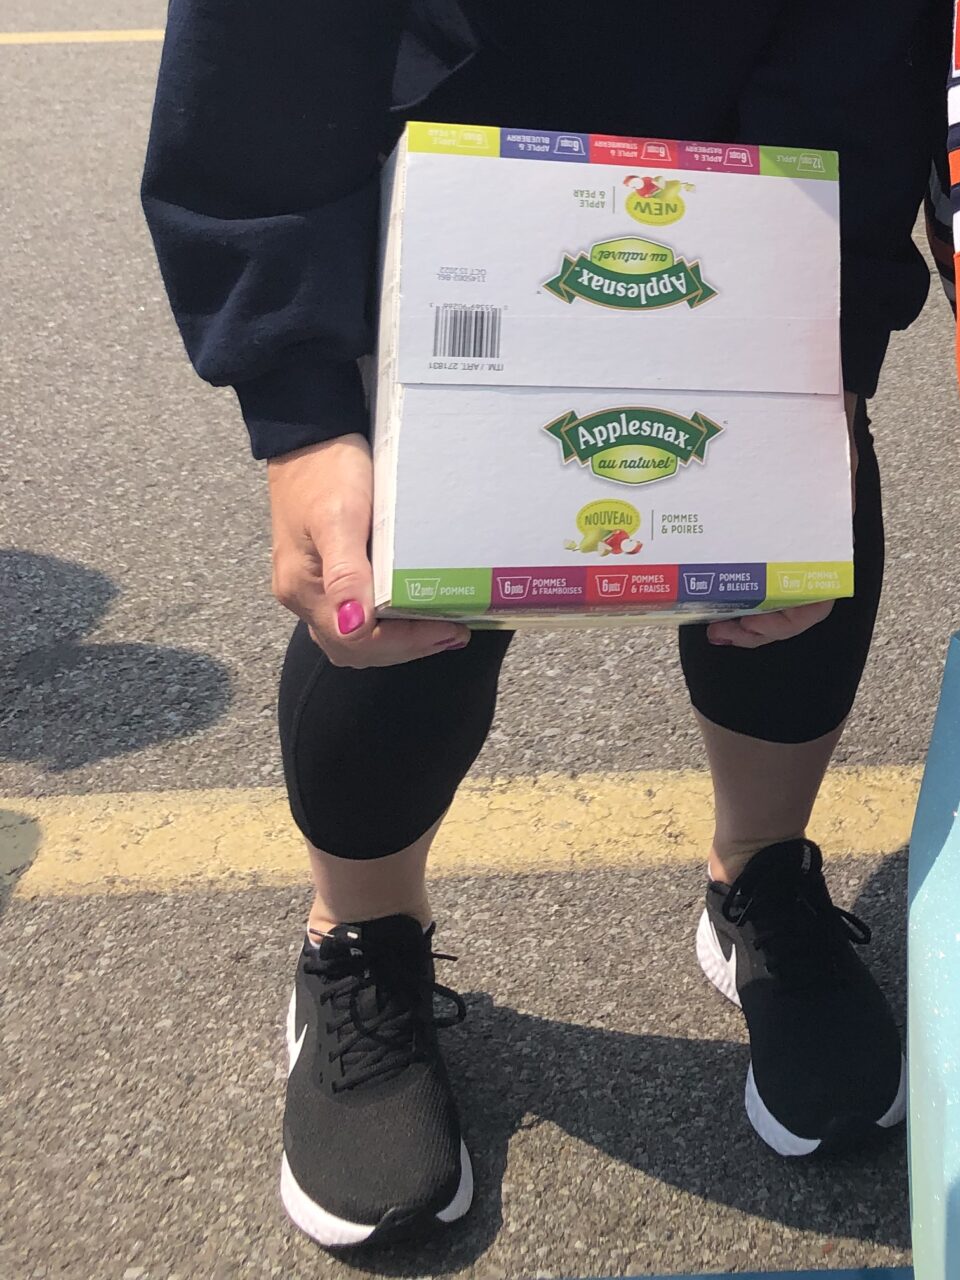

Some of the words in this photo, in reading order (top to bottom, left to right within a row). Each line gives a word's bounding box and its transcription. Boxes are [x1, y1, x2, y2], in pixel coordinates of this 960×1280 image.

[507, 134, 550, 143] BLUEBERRY
[529, 143, 550, 152] APPLE
[594, 140, 638, 150] STRAWBERRY
[685, 145, 723, 154] RASPBERRY
[618, 149, 638, 158] APPLE
[702, 153, 723, 163] APPLE
[573, 189, 597, 199] PEAR
[579, 199, 605, 209] APPLE
[634, 201, 678, 216] NEW
[598, 249, 649, 263] naturel
[650, 254, 668, 262] au
[577, 268, 687, 305] Applesnax
[577, 412, 690, 450] Applesnax
[598, 459, 617, 469] au
[619, 455, 671, 469] naturel
[584, 510, 633, 526] NOUVEAU
[661, 514, 698, 523] POMMES
[661, 525, 668, 534] &
[671, 524, 704, 534] POIRES
[631, 574, 664, 584] POMMES
[719, 572, 751, 582] POMMES
[532, 578, 567, 587] POMMES
[719, 583, 725, 592] &
[727, 582, 759, 592] BLEUETS
[440, 586, 475, 596] POMMES
[532, 587, 538, 596] &
[539, 586, 583, 595] FRAMBOISES
[631, 584, 637, 593] &
[639, 583, 671, 593] FRAISES
